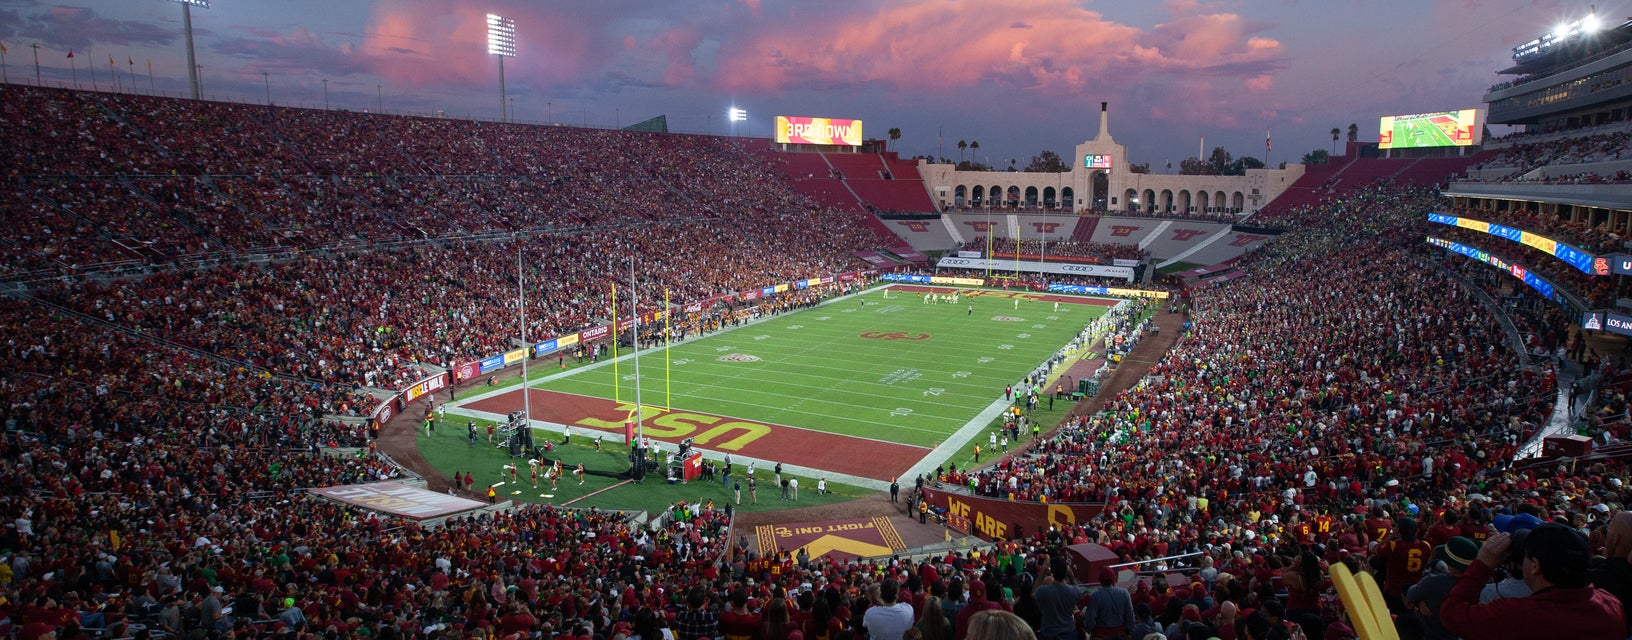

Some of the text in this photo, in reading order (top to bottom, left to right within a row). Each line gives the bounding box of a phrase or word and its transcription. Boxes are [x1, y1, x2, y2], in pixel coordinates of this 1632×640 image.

[817, 125, 855, 139] DOWN
[1607, 318, 1621, 328] LOS
[428, 374, 444, 391] MILK
[573, 404, 772, 451] USC
[948, 495, 971, 518] WE
[975, 511, 1007, 541] ARE
[795, 521, 875, 535] FIGHT ON!
[1302, 525, 1309, 535] 6
[1318, 521, 1330, 532] 14
[1377, 527, 1388, 542] 7
[1407, 548, 1423, 572] 6
[771, 565, 781, 575] 21
